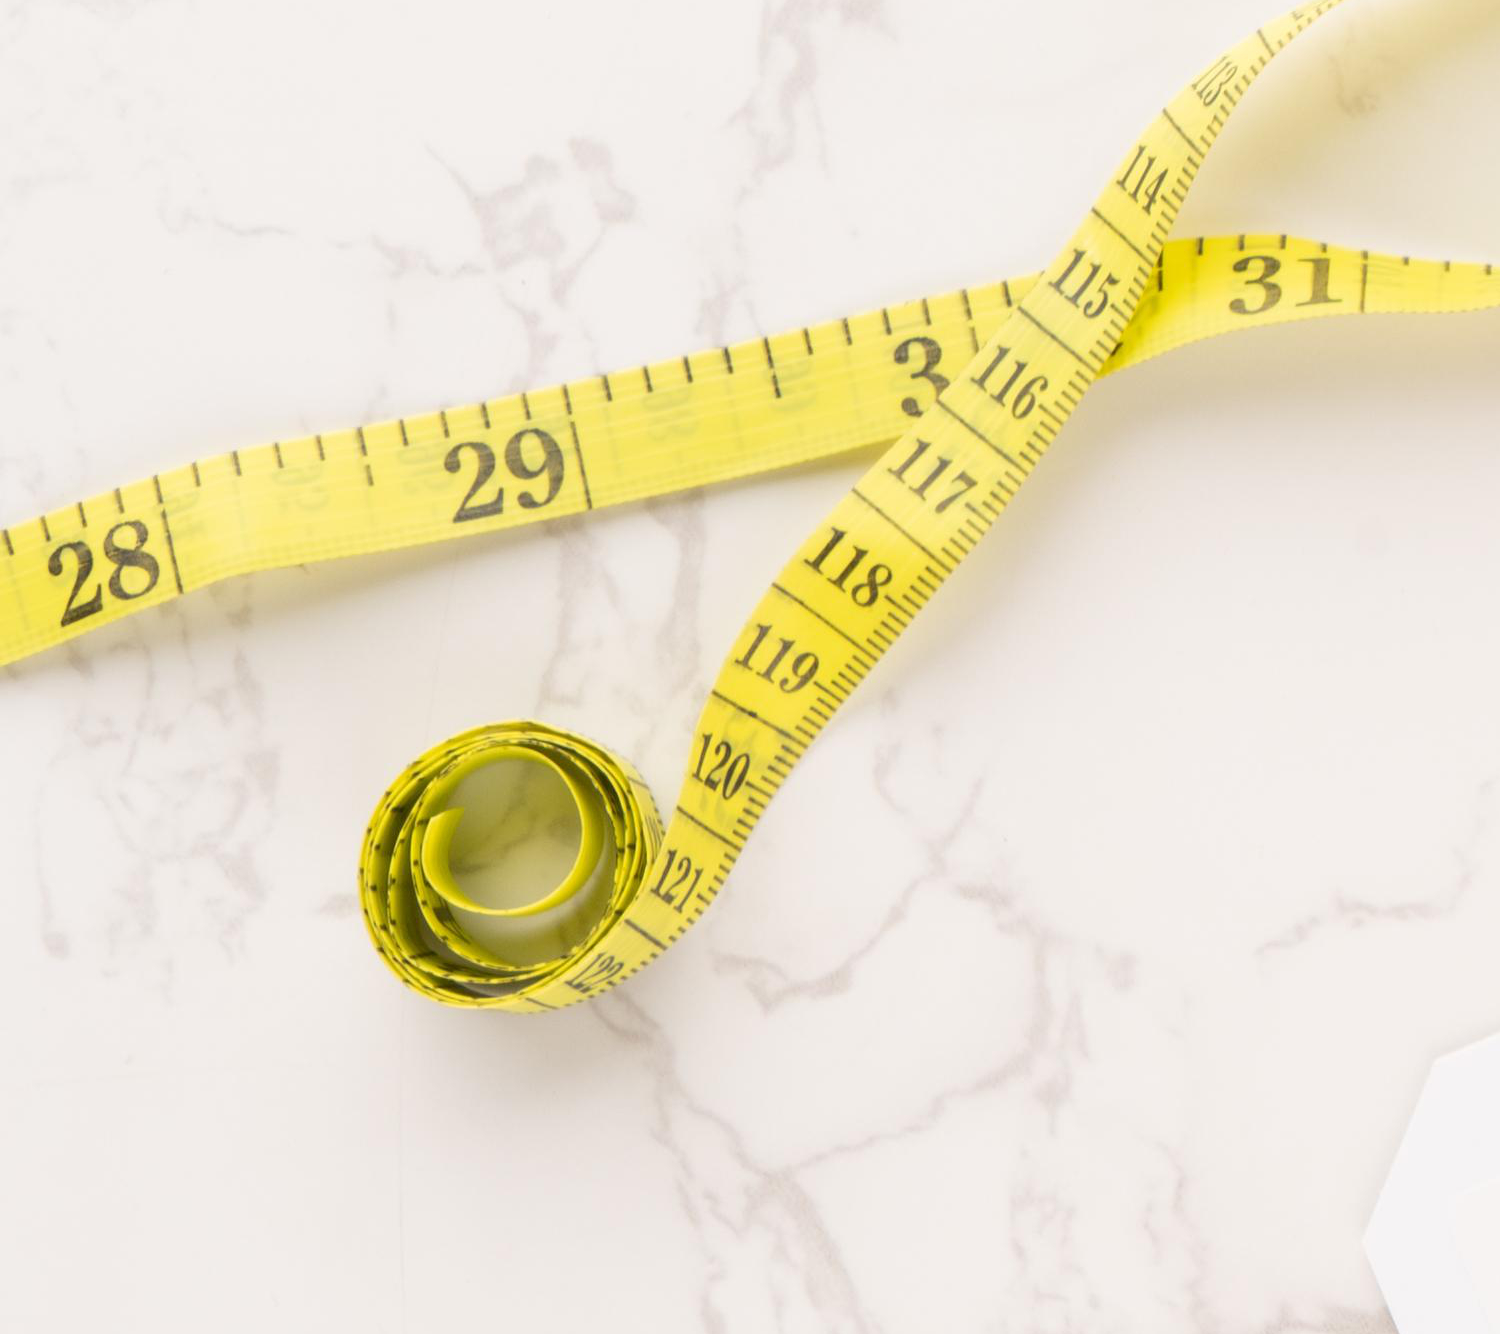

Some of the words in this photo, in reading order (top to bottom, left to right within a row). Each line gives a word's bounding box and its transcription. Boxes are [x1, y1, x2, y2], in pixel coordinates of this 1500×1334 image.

[1191, 55, 1235, 107] 113
[1116, 144, 1167, 216] 114
[1048, 247, 1120, 319] 115
[1228, 256, 1343, 315] 31
[894, 337, 948, 418] 3
[970, 345, 1048, 420] 116
[443, 427, 566, 522] 29
[886, 437, 978, 514] 117
[46, 520, 160, 628] 28
[803, 527, 892, 607] 118
[734, 624, 819, 693] 119
[691, 733, 751, 800] 120
[650, 849, 703, 913] 121
[565, 953, 624, 993] 122
